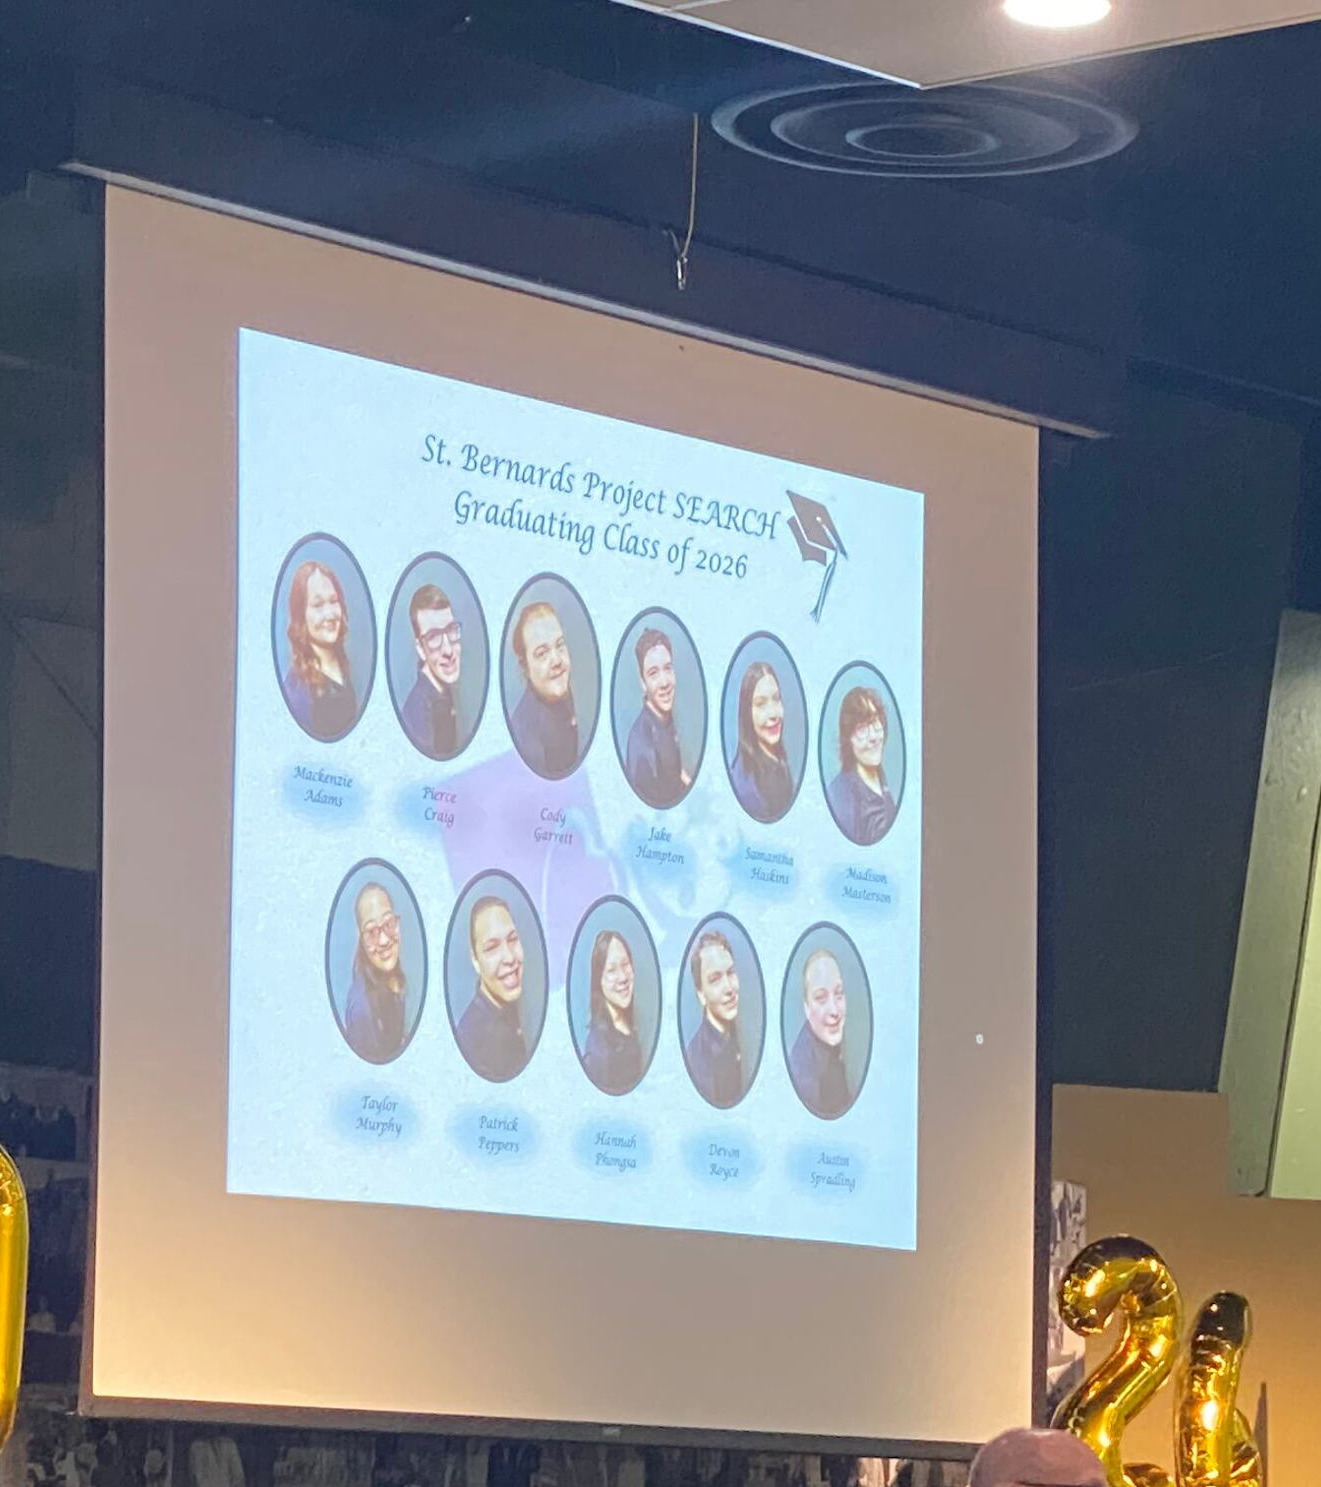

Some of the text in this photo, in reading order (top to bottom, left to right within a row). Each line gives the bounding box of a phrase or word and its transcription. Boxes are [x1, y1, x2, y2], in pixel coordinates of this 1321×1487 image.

[422, 433, 781, 540] St. Bernards Project SEARCH
[454, 490, 748, 579] Graduating Class of 2026
[293, 765, 354, 789] Mackenzie
[304, 789, 344, 808] Adams
[422, 786, 456, 804] Pierce
[424, 807, 455, 827] Craig
[540, 807, 567, 827] Cody
[533, 827, 573, 846] Garrett
[648, 826, 672, 843] Jake
[635, 845, 685, 866] Hampton
[745, 847, 795, 867] Samantha
[845, 866, 888, 885] Madison
[841, 885, 892, 904] Masterson
[361, 1095, 398, 1114] Taylor
[355, 1117, 402, 1138] Murphy
[479, 1115, 519, 1133] Patrick
[478, 1136, 520, 1156] Peppers
[594, 1131, 637, 1149] Hannah
